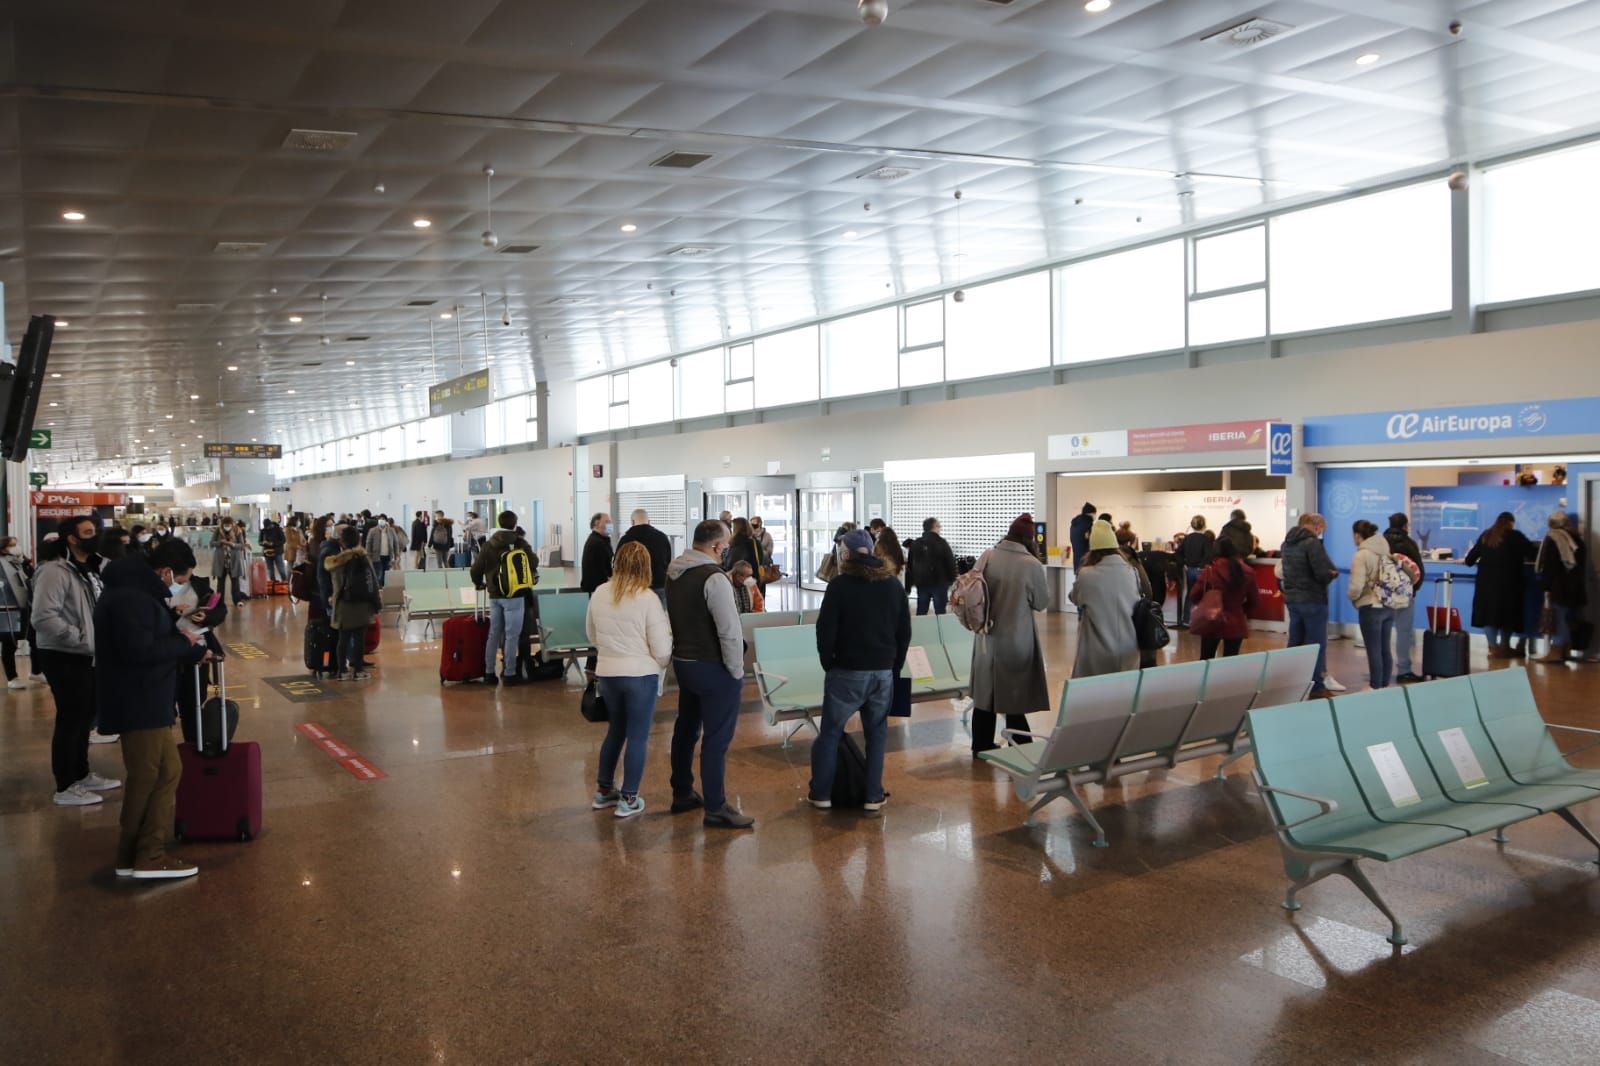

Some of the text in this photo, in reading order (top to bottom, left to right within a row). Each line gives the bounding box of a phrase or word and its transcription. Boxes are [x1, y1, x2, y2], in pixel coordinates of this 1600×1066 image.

[1422, 414, 1512, 433] AirEuropa
[1208, 431, 1246, 442] IBERIA
[1203, 496, 1233, 504] IBERIA
